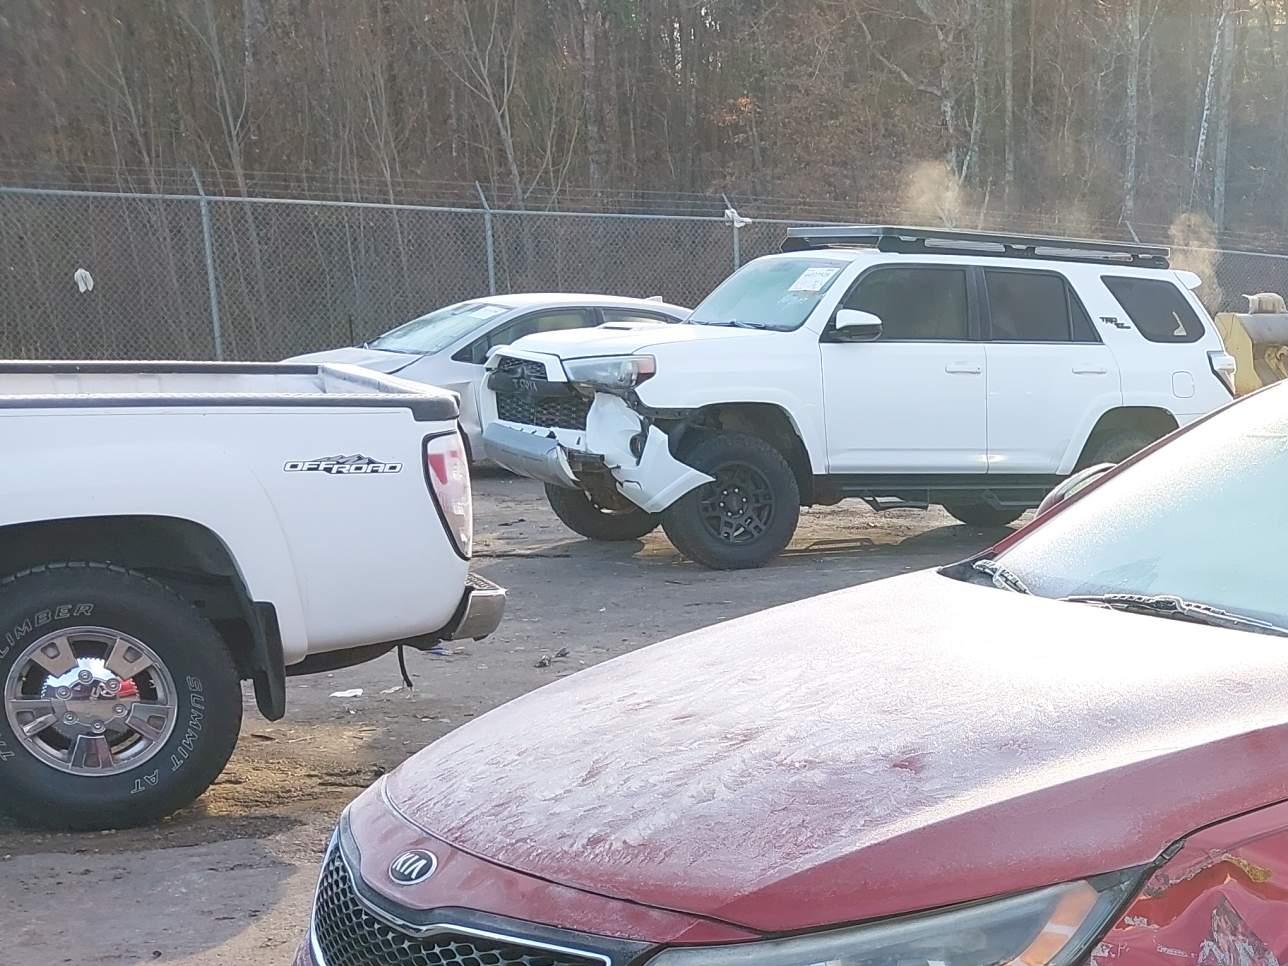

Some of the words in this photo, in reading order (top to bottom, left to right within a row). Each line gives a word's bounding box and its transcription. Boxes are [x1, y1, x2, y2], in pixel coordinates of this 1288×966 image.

[169, 674, 206, 772] SUMMIT
[129, 768, 160, 795] AT
[392, 853, 427, 879] KIA
